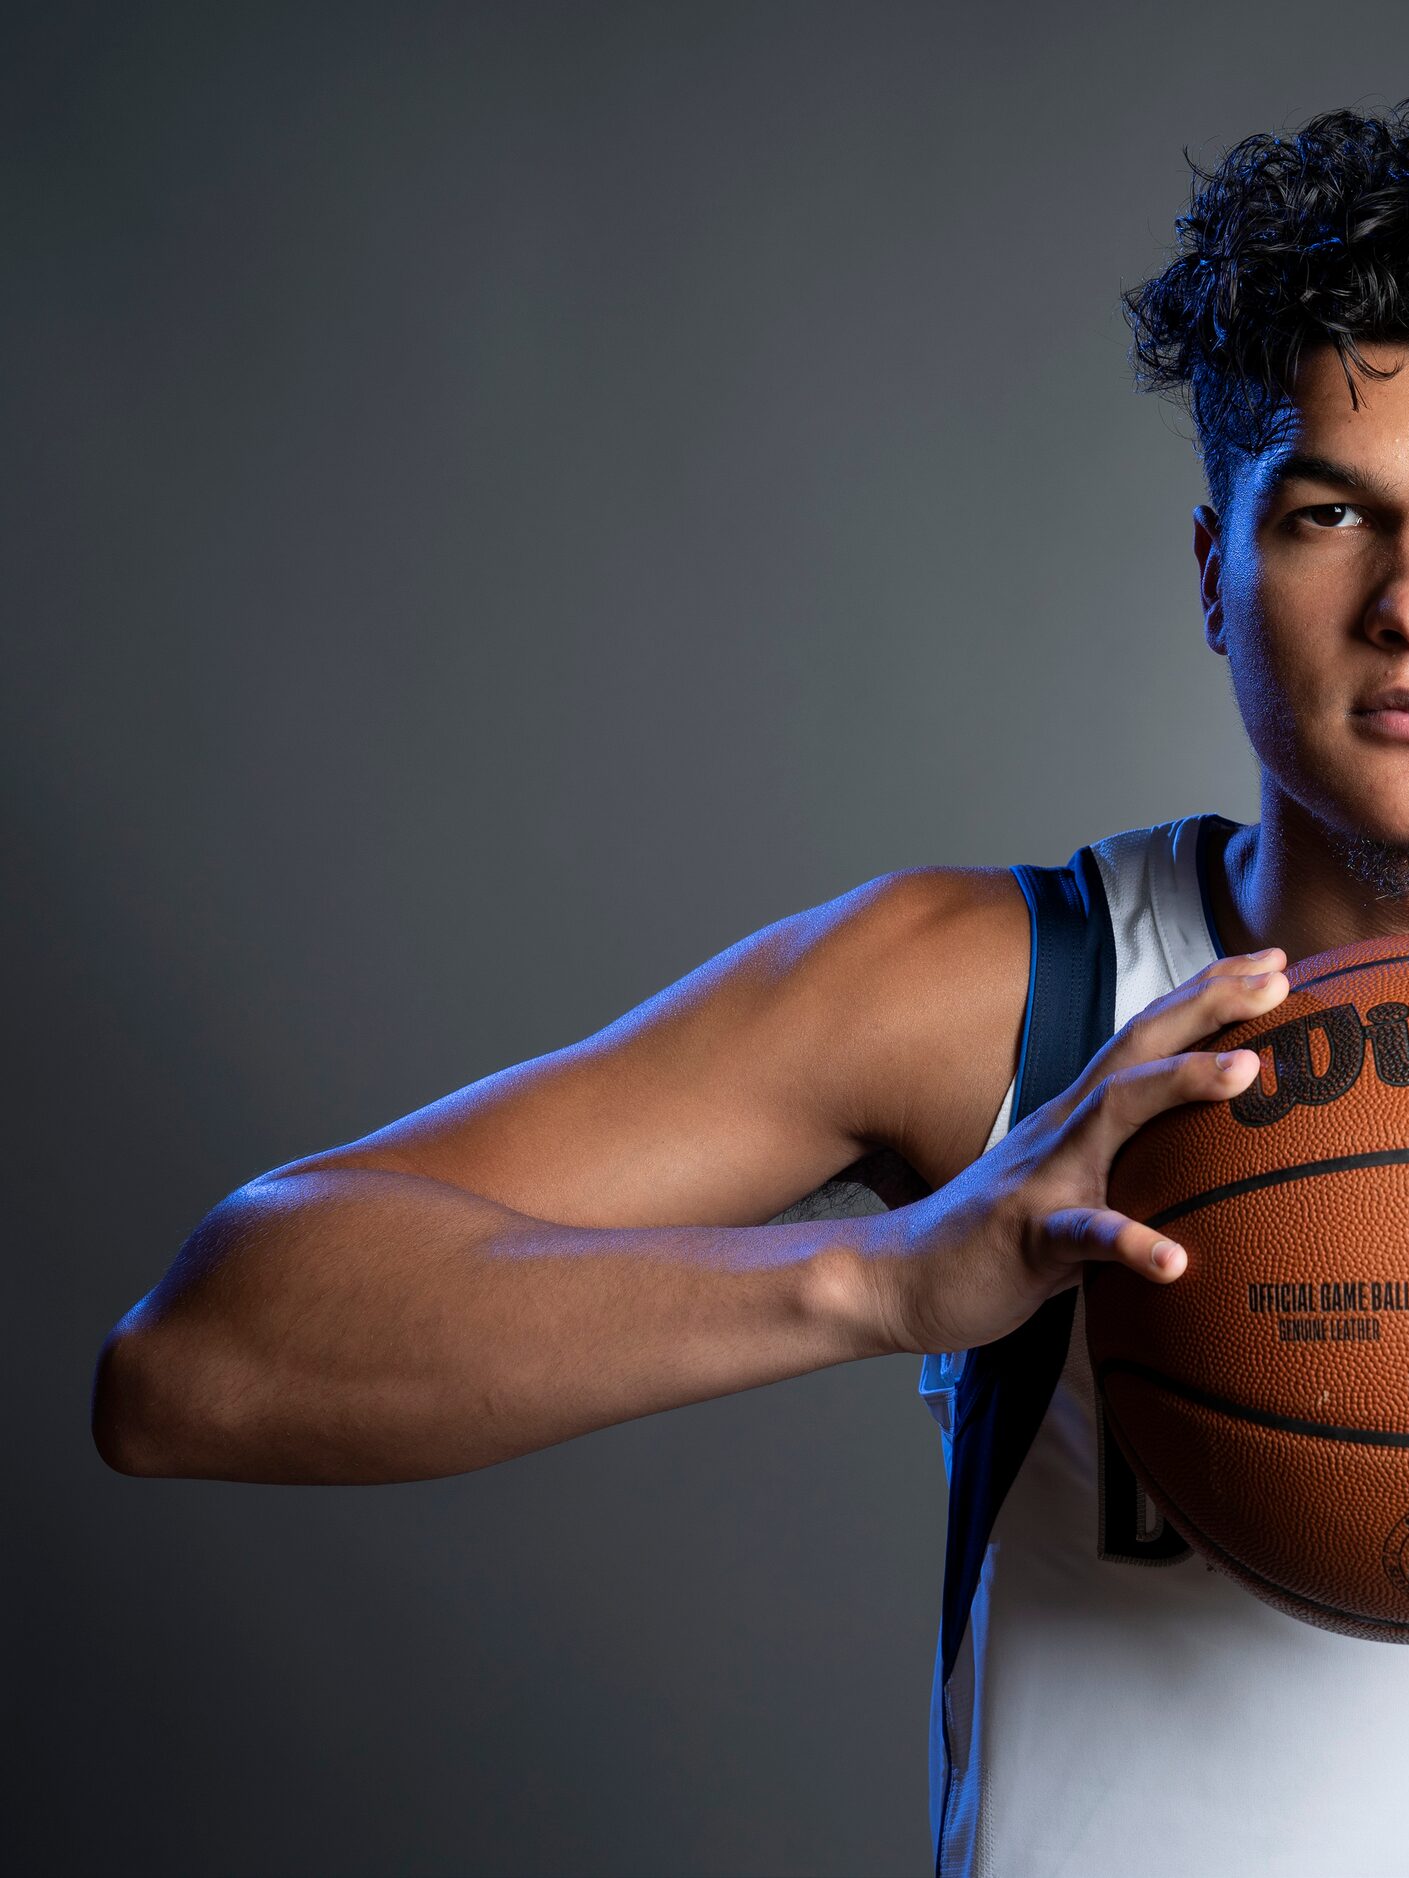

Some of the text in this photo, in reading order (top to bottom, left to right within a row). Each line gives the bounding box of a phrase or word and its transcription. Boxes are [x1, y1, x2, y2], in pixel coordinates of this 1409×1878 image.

[1248, 1283, 1315, 1312] OFFICIAL
[1320, 1283, 1368, 1312] GAME
[1279, 1318, 1380, 1342] GENUINE LEATHER
